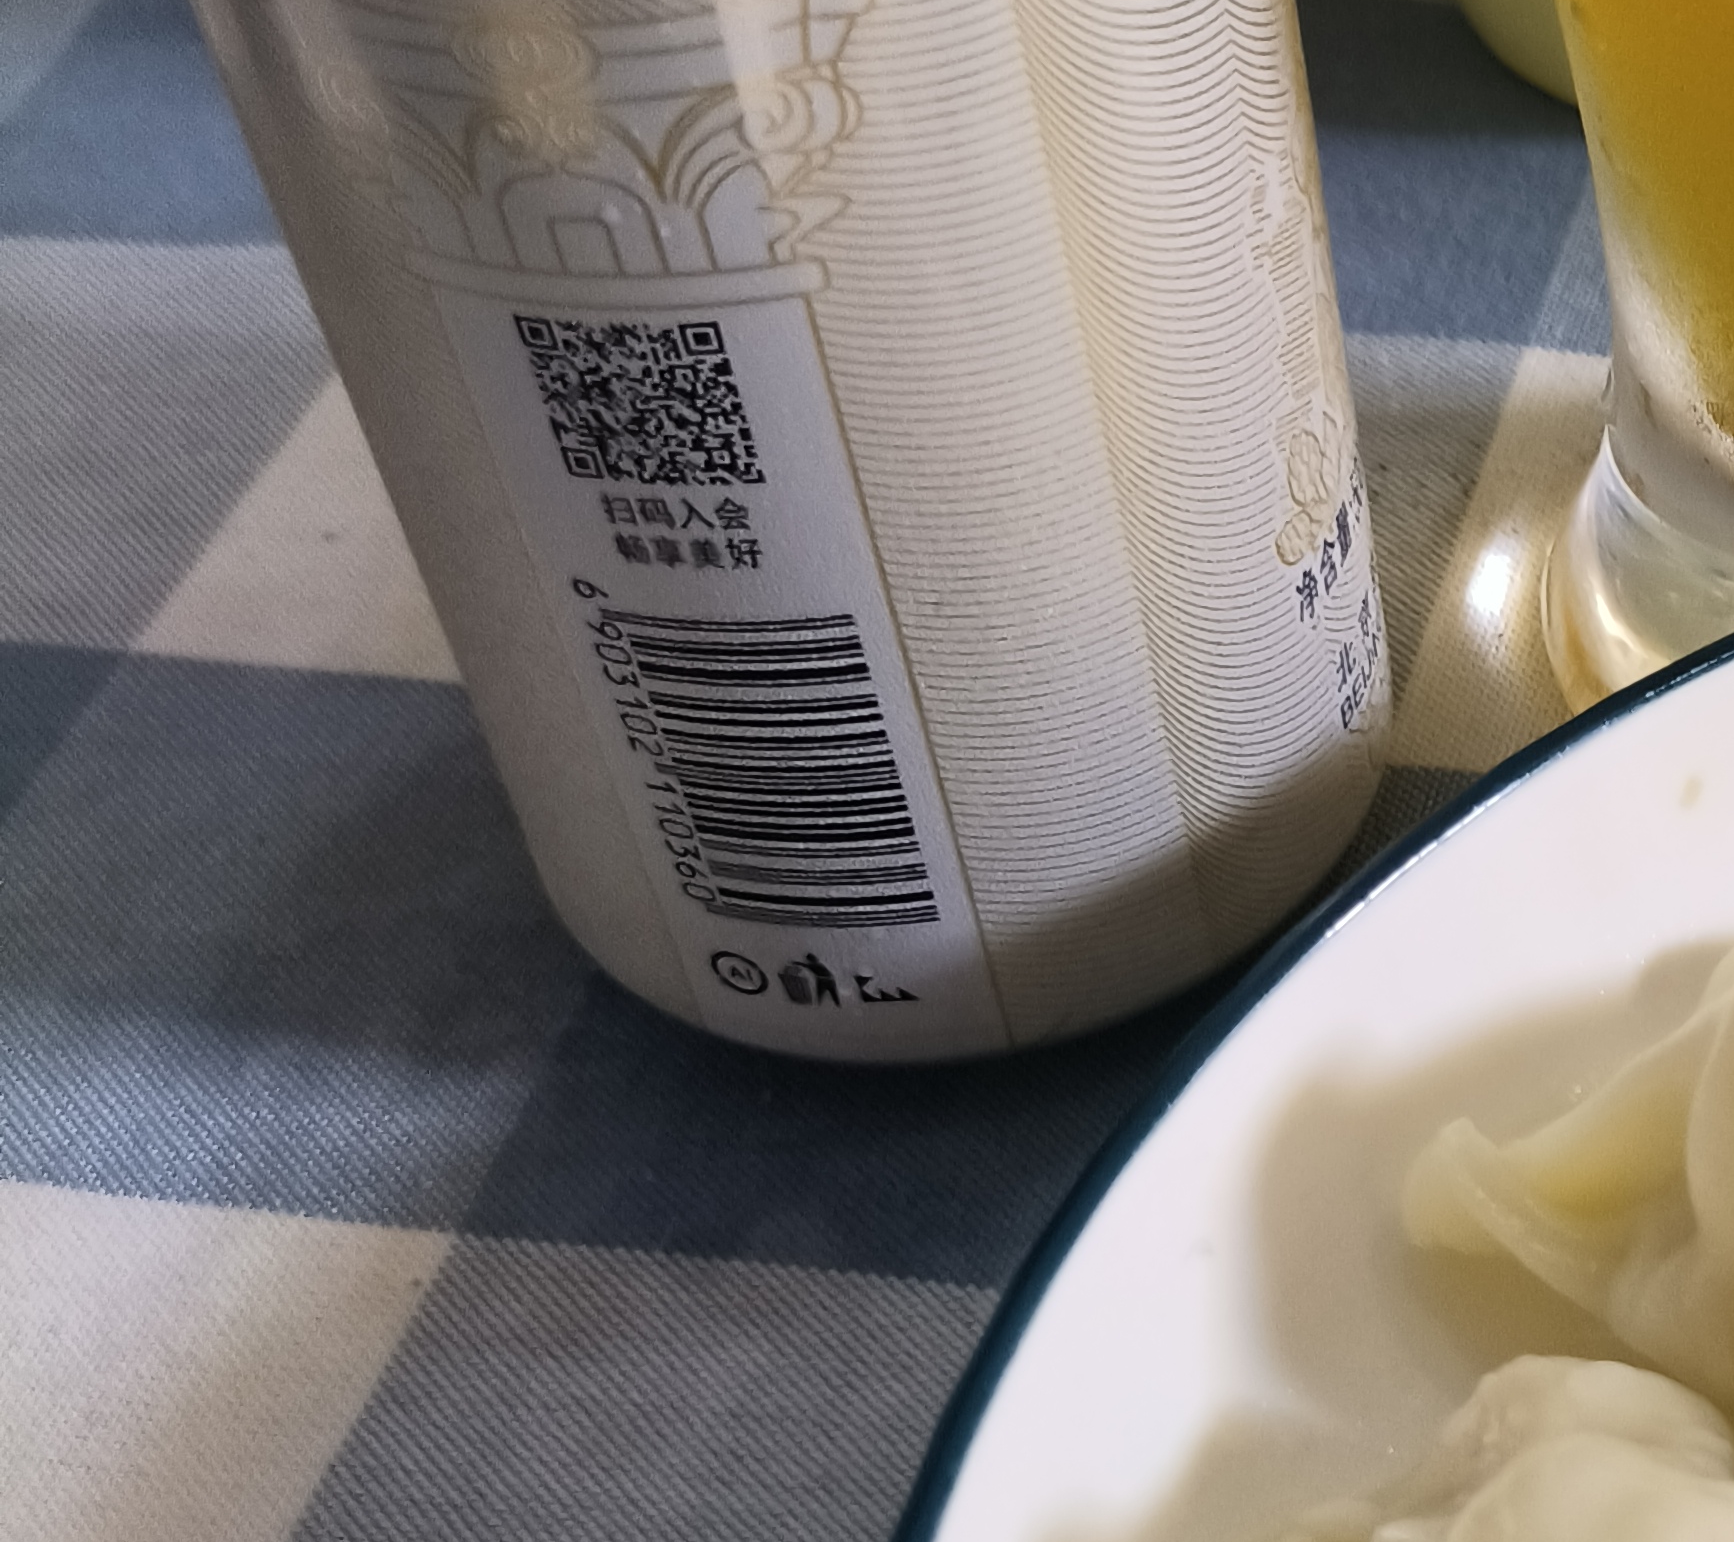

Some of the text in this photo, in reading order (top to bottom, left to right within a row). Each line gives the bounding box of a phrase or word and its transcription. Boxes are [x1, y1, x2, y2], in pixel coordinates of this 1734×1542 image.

[601, 493, 751, 530] 扫码入会
[573, 578, 716, 902] 6 903102 110360
